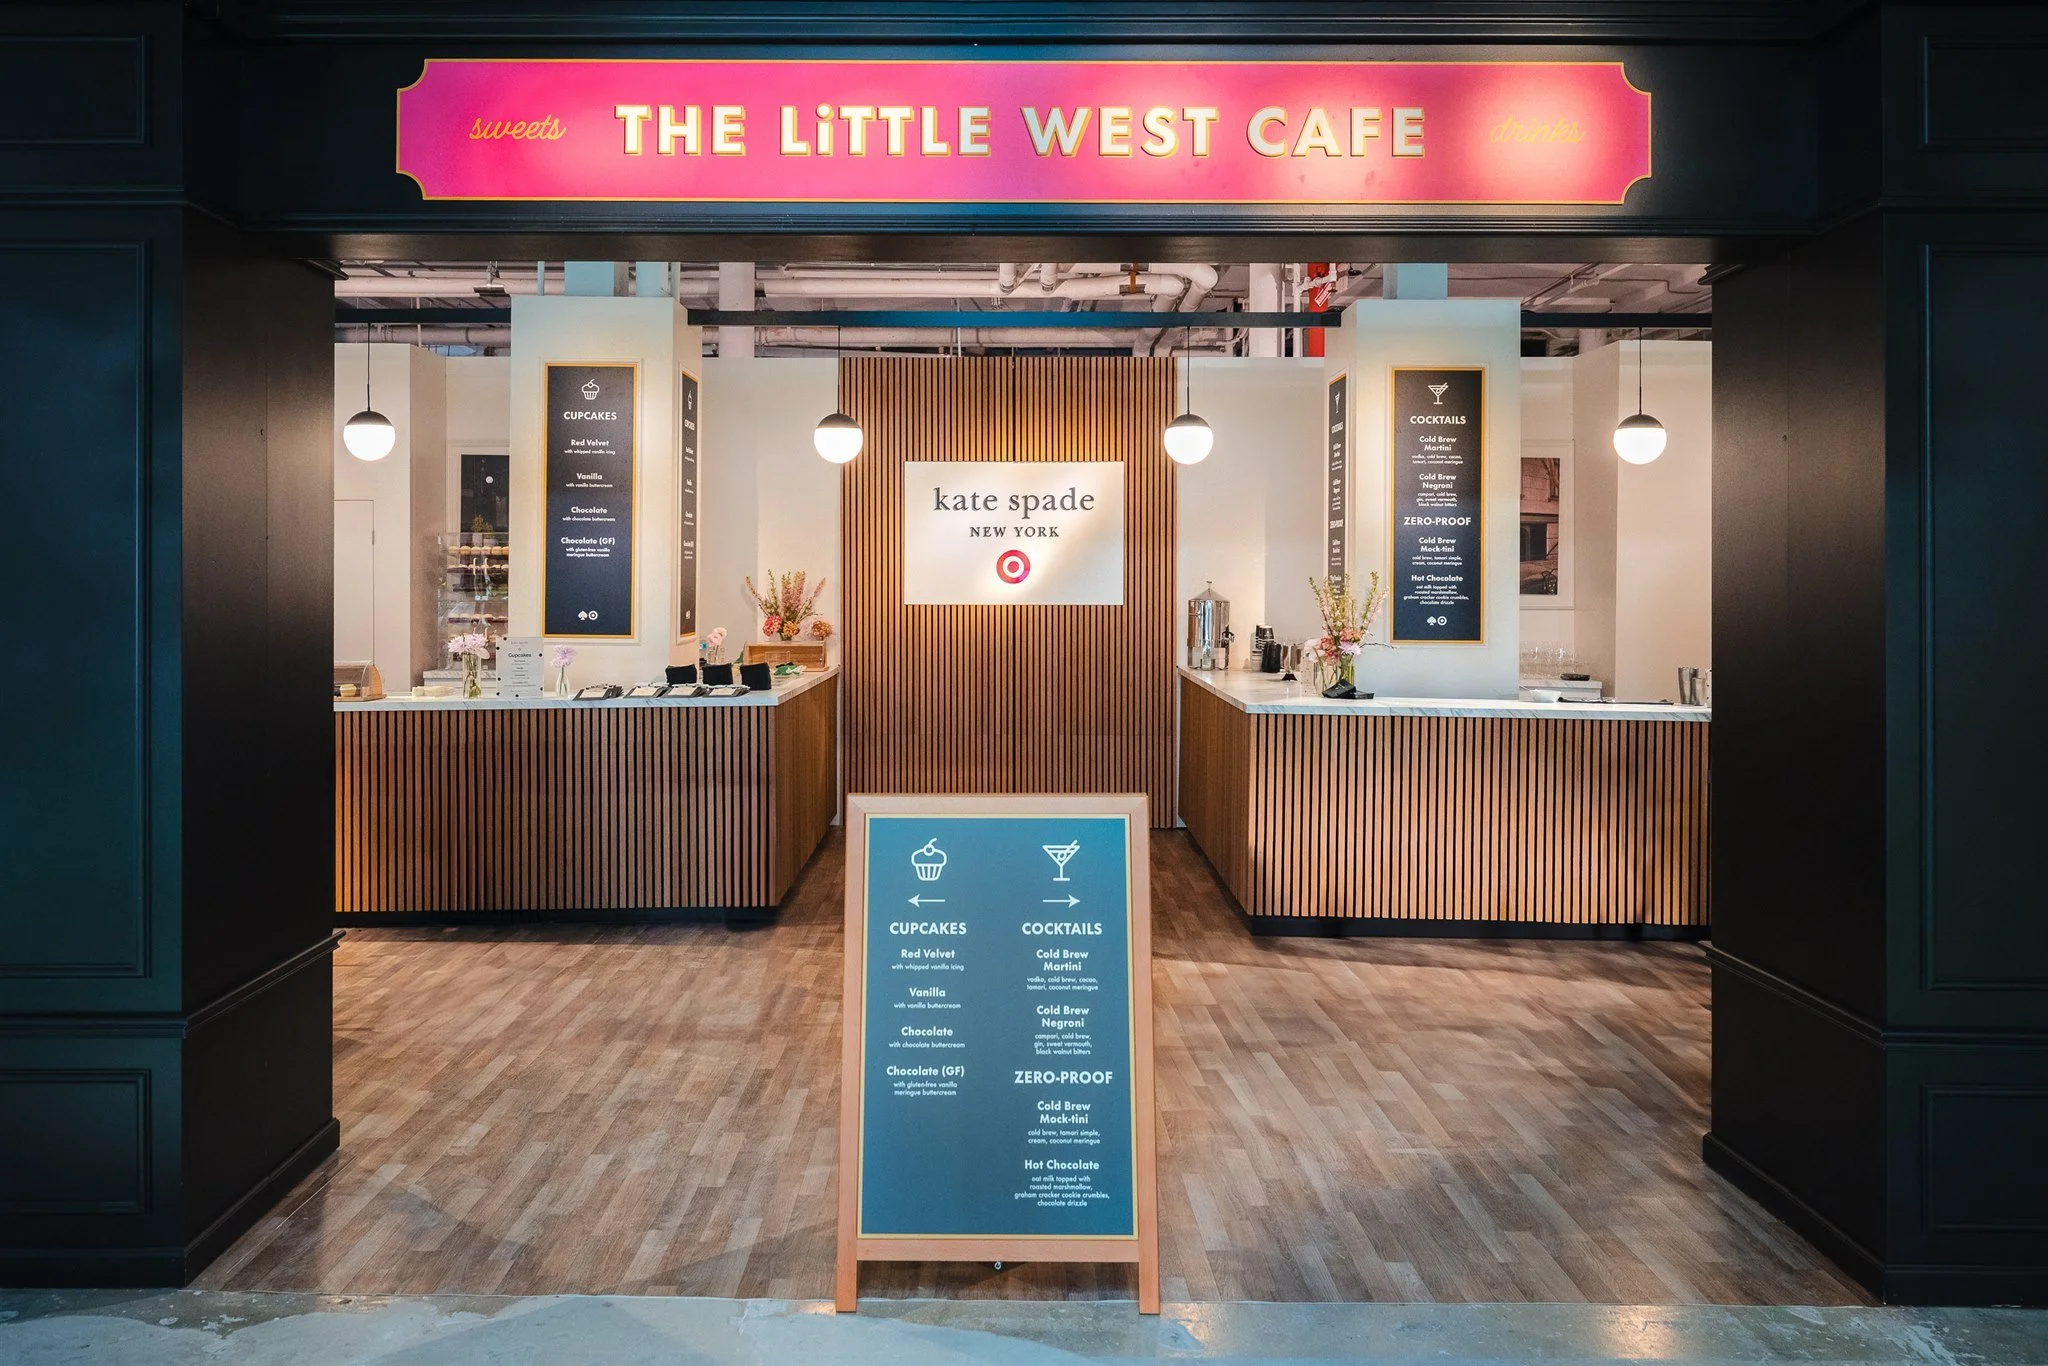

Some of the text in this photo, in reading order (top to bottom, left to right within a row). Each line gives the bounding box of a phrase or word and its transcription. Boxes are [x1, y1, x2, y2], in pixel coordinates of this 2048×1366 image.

[469, 114, 567, 140] sweets
[614, 104, 746, 157] THE
[1021, 105, 1220, 158] WEST
[1247, 106, 1426, 158] CAFE
[1490, 114, 1587, 143] drinks
[564, 411, 617, 420] CUPCAKES
[1410, 416, 1466, 425] COCKTAILS
[1422, 482, 1452, 490] Negroni
[934, 487, 1095, 519] kate spade
[571, 506, 607, 514] Chocolate
[1404, 517, 1471, 526] ZERO-PROOF
[970, 526, 1060, 538] NEW YORK
[599, 537, 615, 545] (GF)
[1411, 574, 1463, 582] Hot Chocolate
[889, 922, 966, 935] CUPCAKES
[1022, 923, 1102, 935] COCKTAILS
[901, 949, 955, 959] Red Velvet
[1036, 949, 1088, 959] Cold Brew
[905, 963, 929, 971] whipped
[951, 963, 964, 971] icing
[1044, 962, 1082, 971] Martini
[909, 988, 946, 997] Vanilla
[1072, 984, 1098, 992] meringue
[1036, 1006, 1089, 1015] Cold Brew
[1042, 1018, 1085, 1030] Negroni
[901, 1026, 953, 1037] Chocolate
[886, 1066, 965, 1078] Chocolate (GF)
[1014, 1071, 1112, 1084] ZERO-PROOF
[907, 1081, 937, 1089] gluten-free
[894, 1089, 921, 1097] meringue
[1037, 1101, 1091, 1111] Cold Brew
[1040, 1114, 1088, 1124] Mock-tini
[1073, 1138, 1100, 1146] meringue
[1025, 1160, 1099, 1170] Hot Chocolate
[1056, 1175, 1077, 1184] topped
[1014, 1192, 1037, 1200] graham
